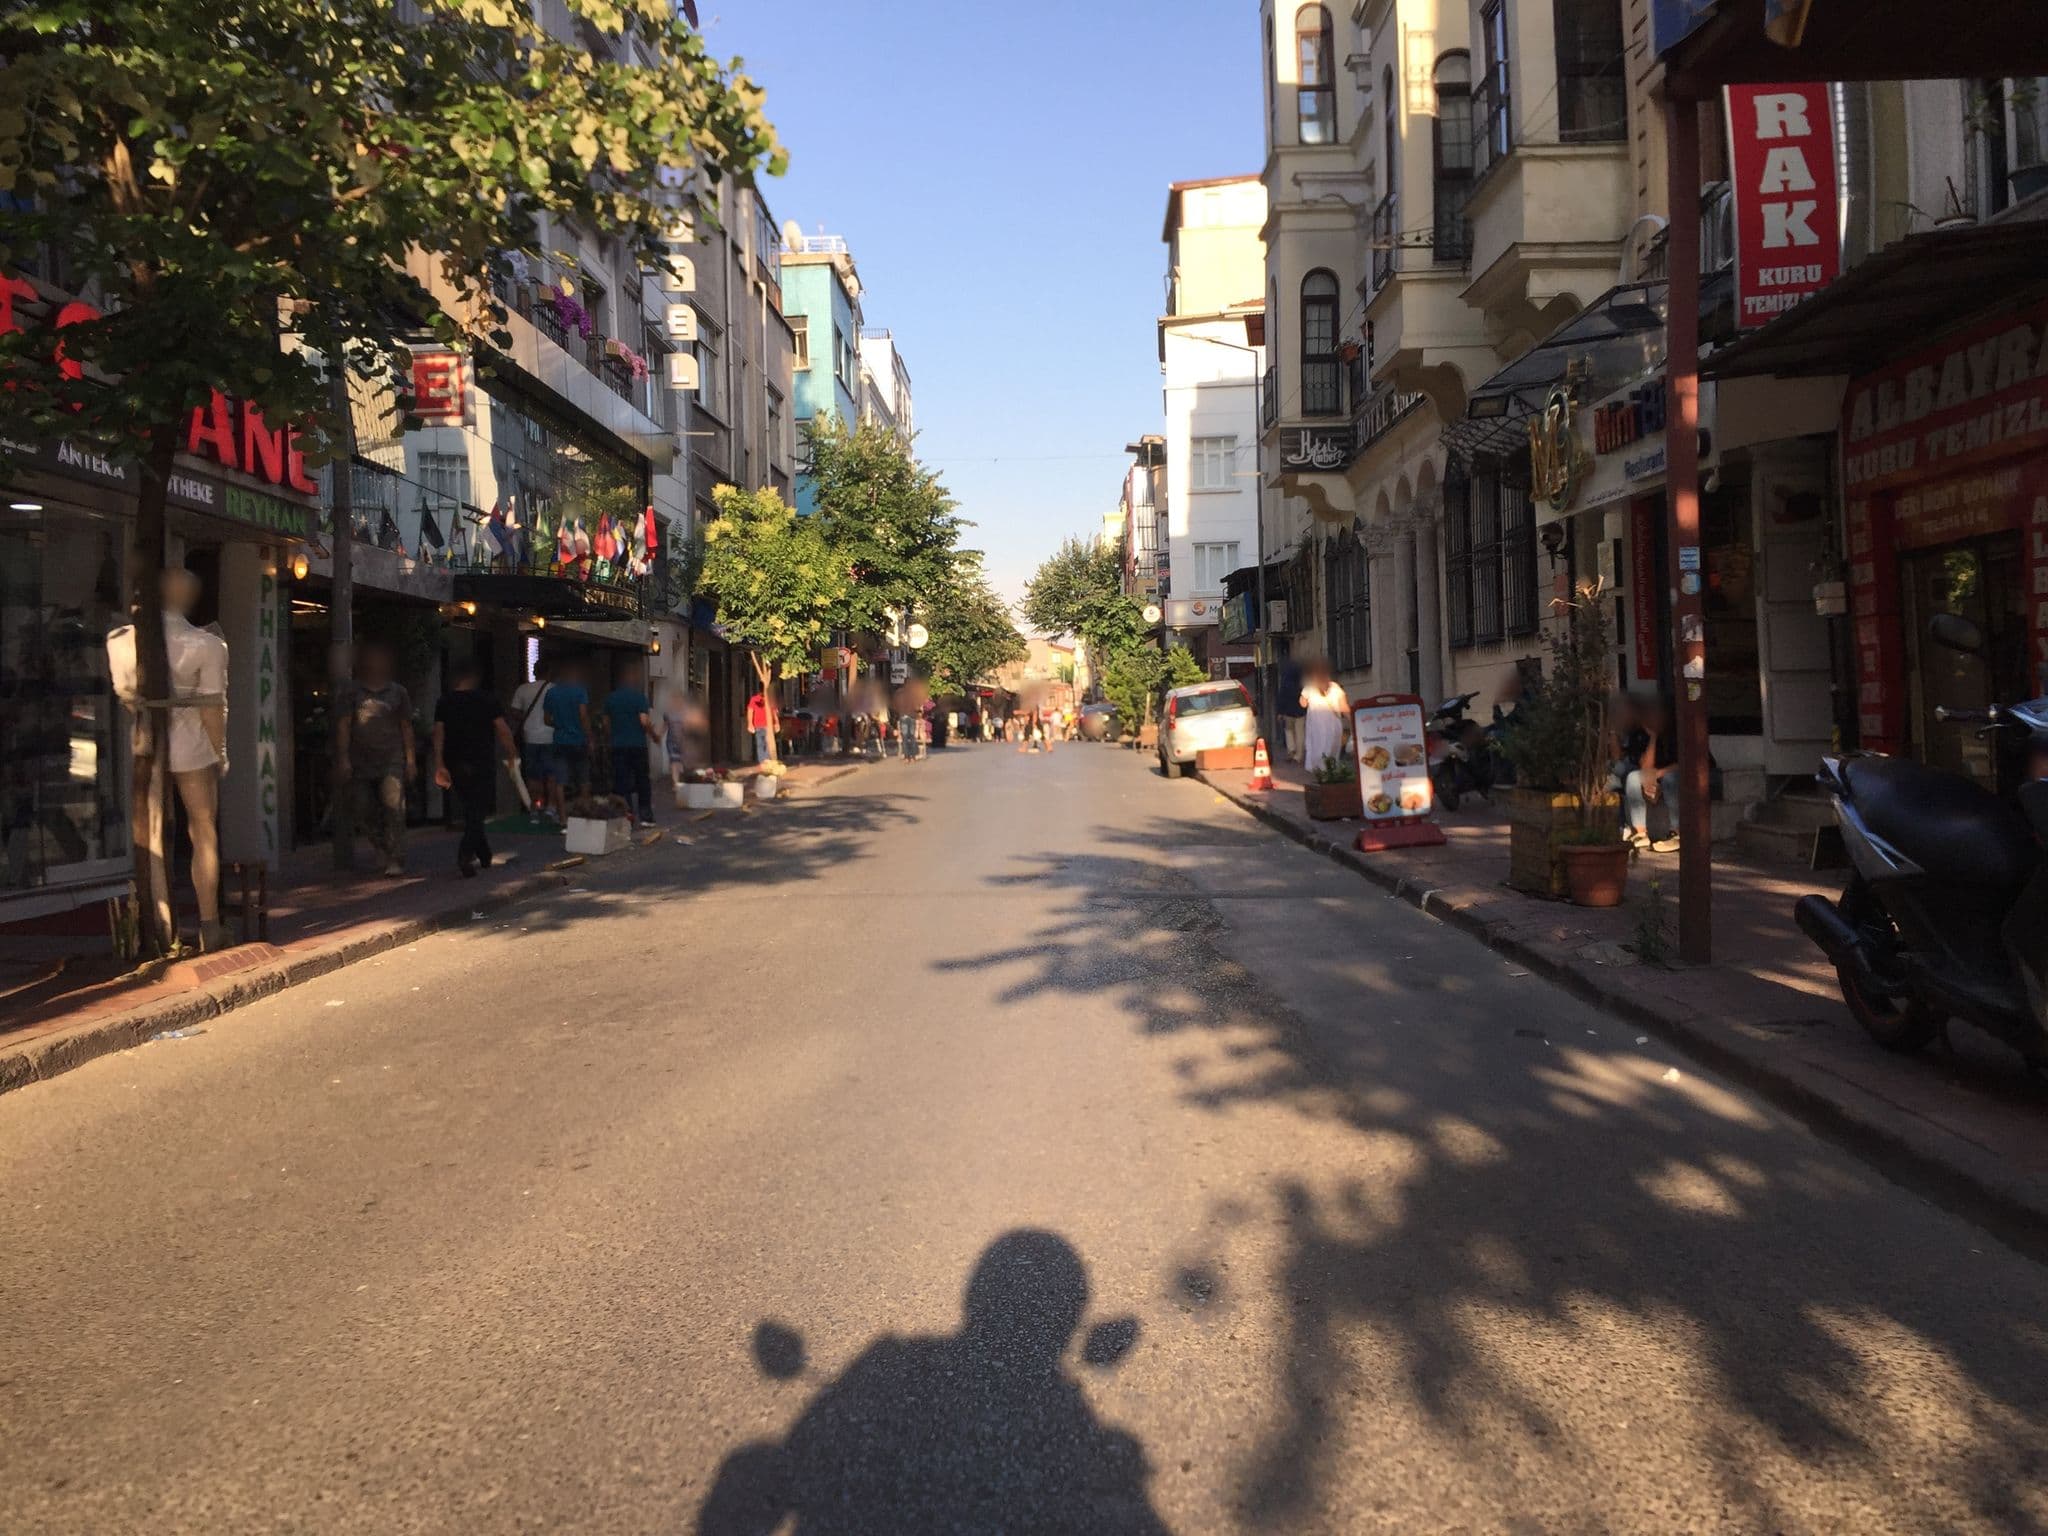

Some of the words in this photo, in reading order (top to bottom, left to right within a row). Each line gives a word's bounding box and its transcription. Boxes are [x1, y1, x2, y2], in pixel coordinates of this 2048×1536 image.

[1753, 93, 1820, 249] RAK
[1758, 264, 1822, 287] KURU
[1356, 397, 1389, 450] HOTEL
[225, 486, 306, 532] REYHAN
